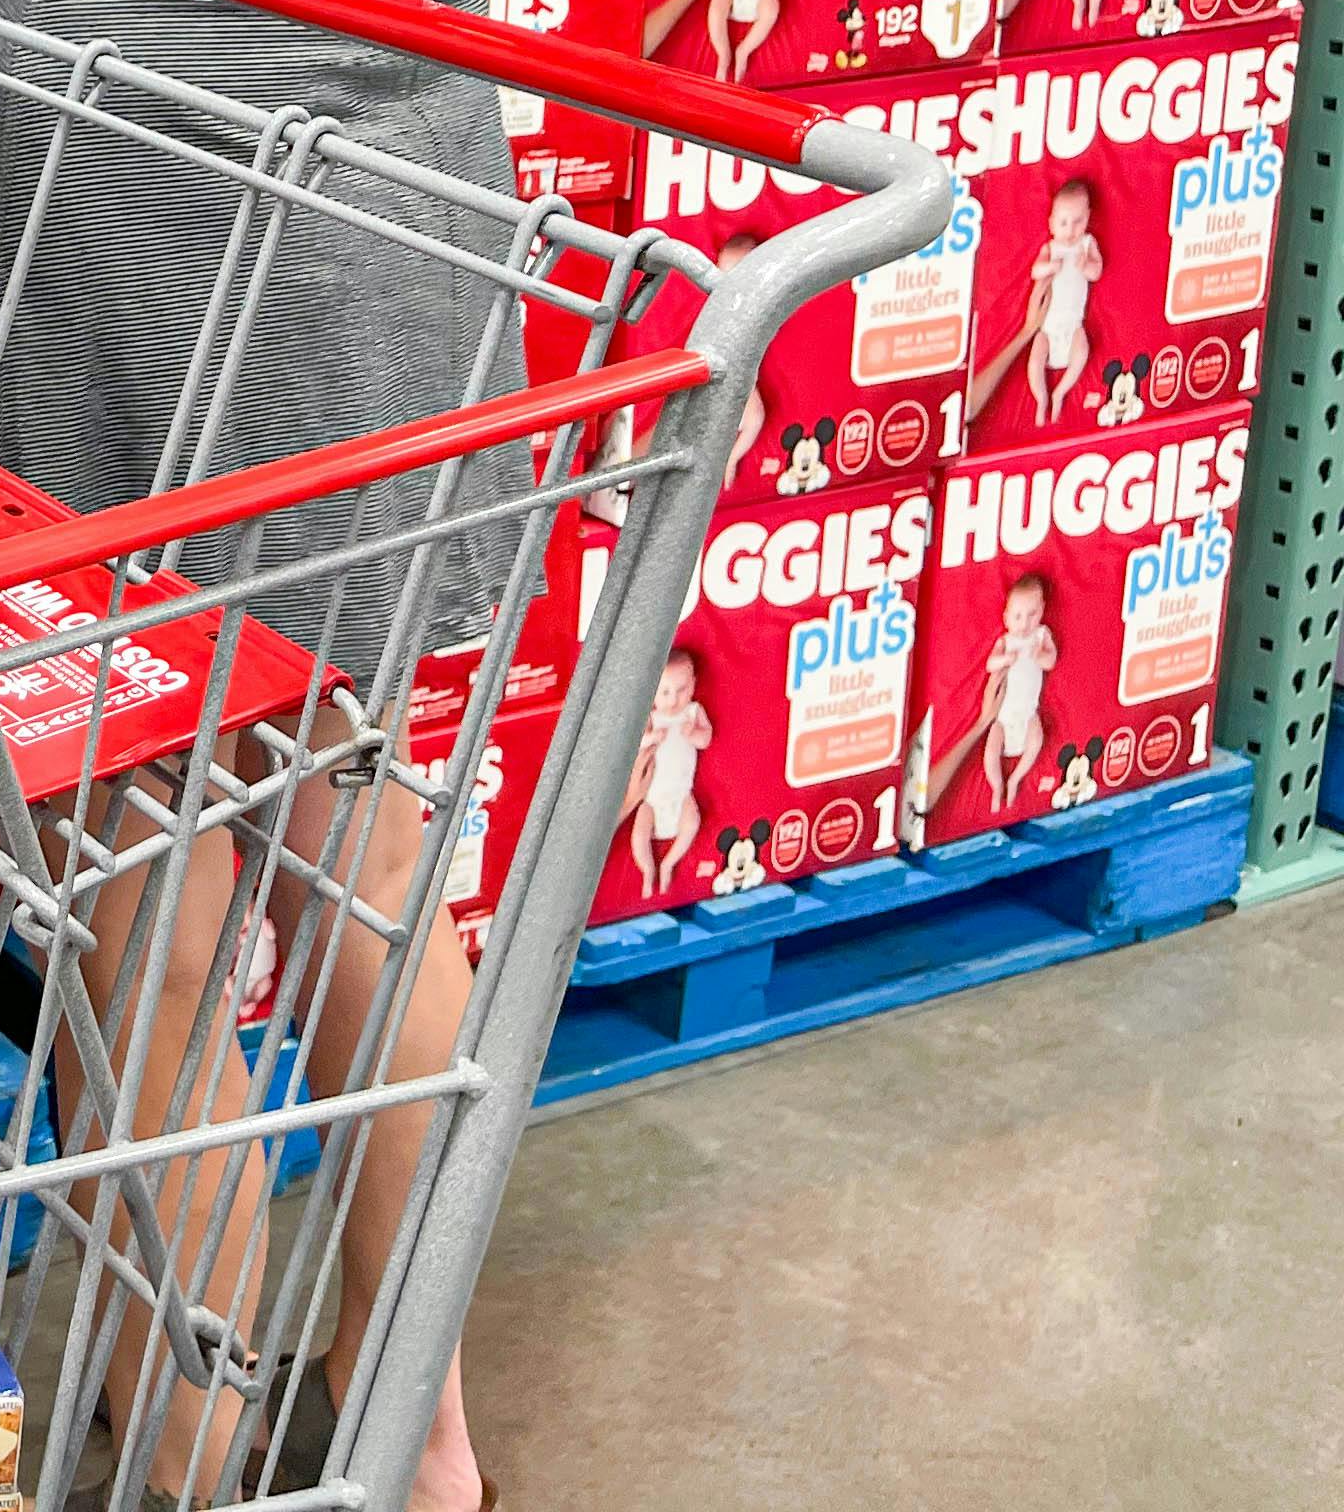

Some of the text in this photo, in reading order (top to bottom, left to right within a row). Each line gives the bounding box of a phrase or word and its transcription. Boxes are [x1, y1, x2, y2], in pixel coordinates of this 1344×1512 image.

[876, 6, 918, 35] 192
[988, 42, 1298, 171] HUGGIES
[941, 427, 1250, 569] HUGGIES
